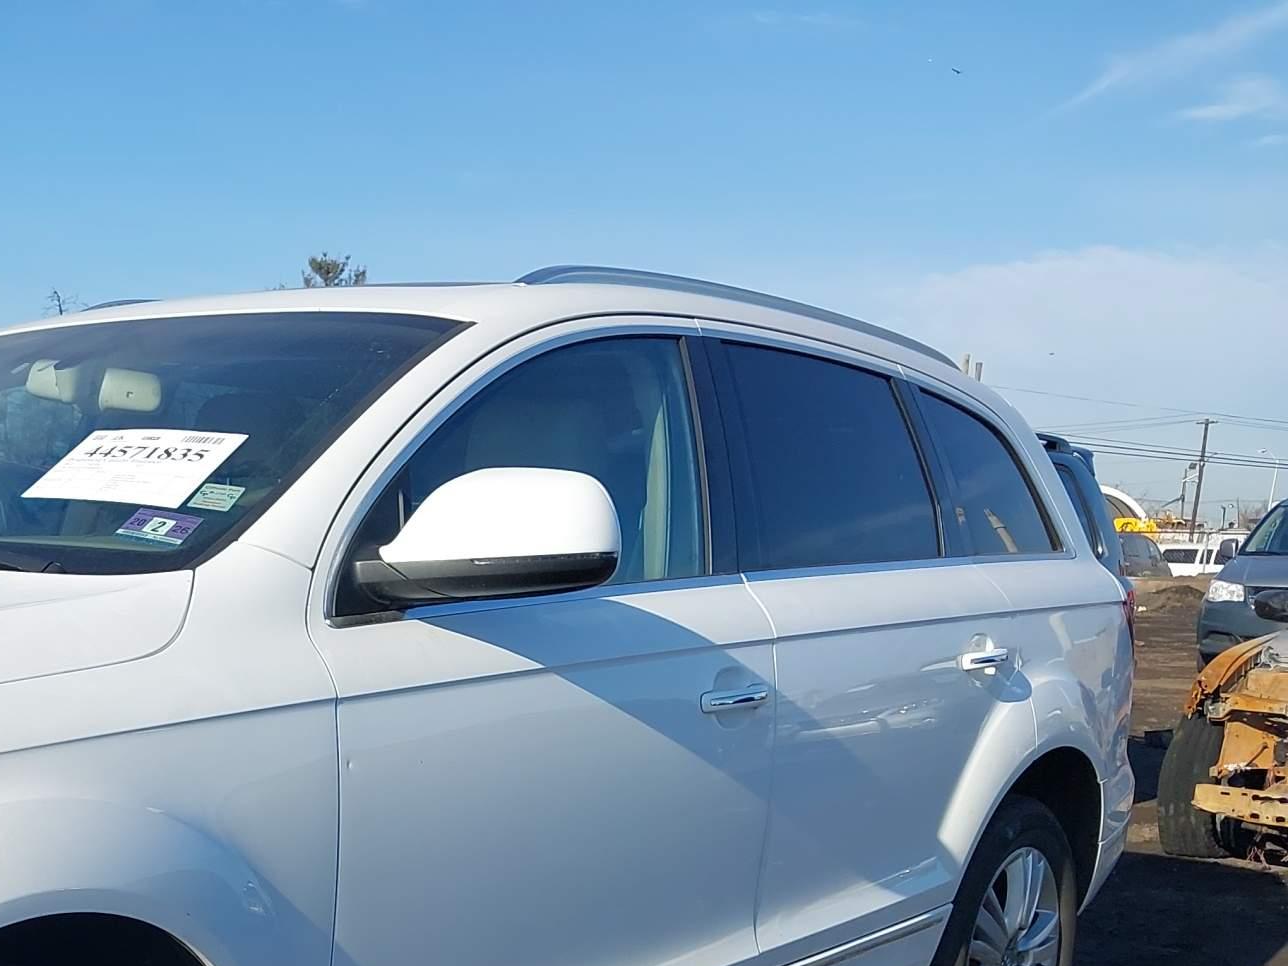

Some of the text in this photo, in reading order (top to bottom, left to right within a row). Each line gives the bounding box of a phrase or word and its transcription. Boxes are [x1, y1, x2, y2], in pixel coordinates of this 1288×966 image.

[84, 445, 211, 462] 44571835
[130, 518, 191, 535] 20 2 26
